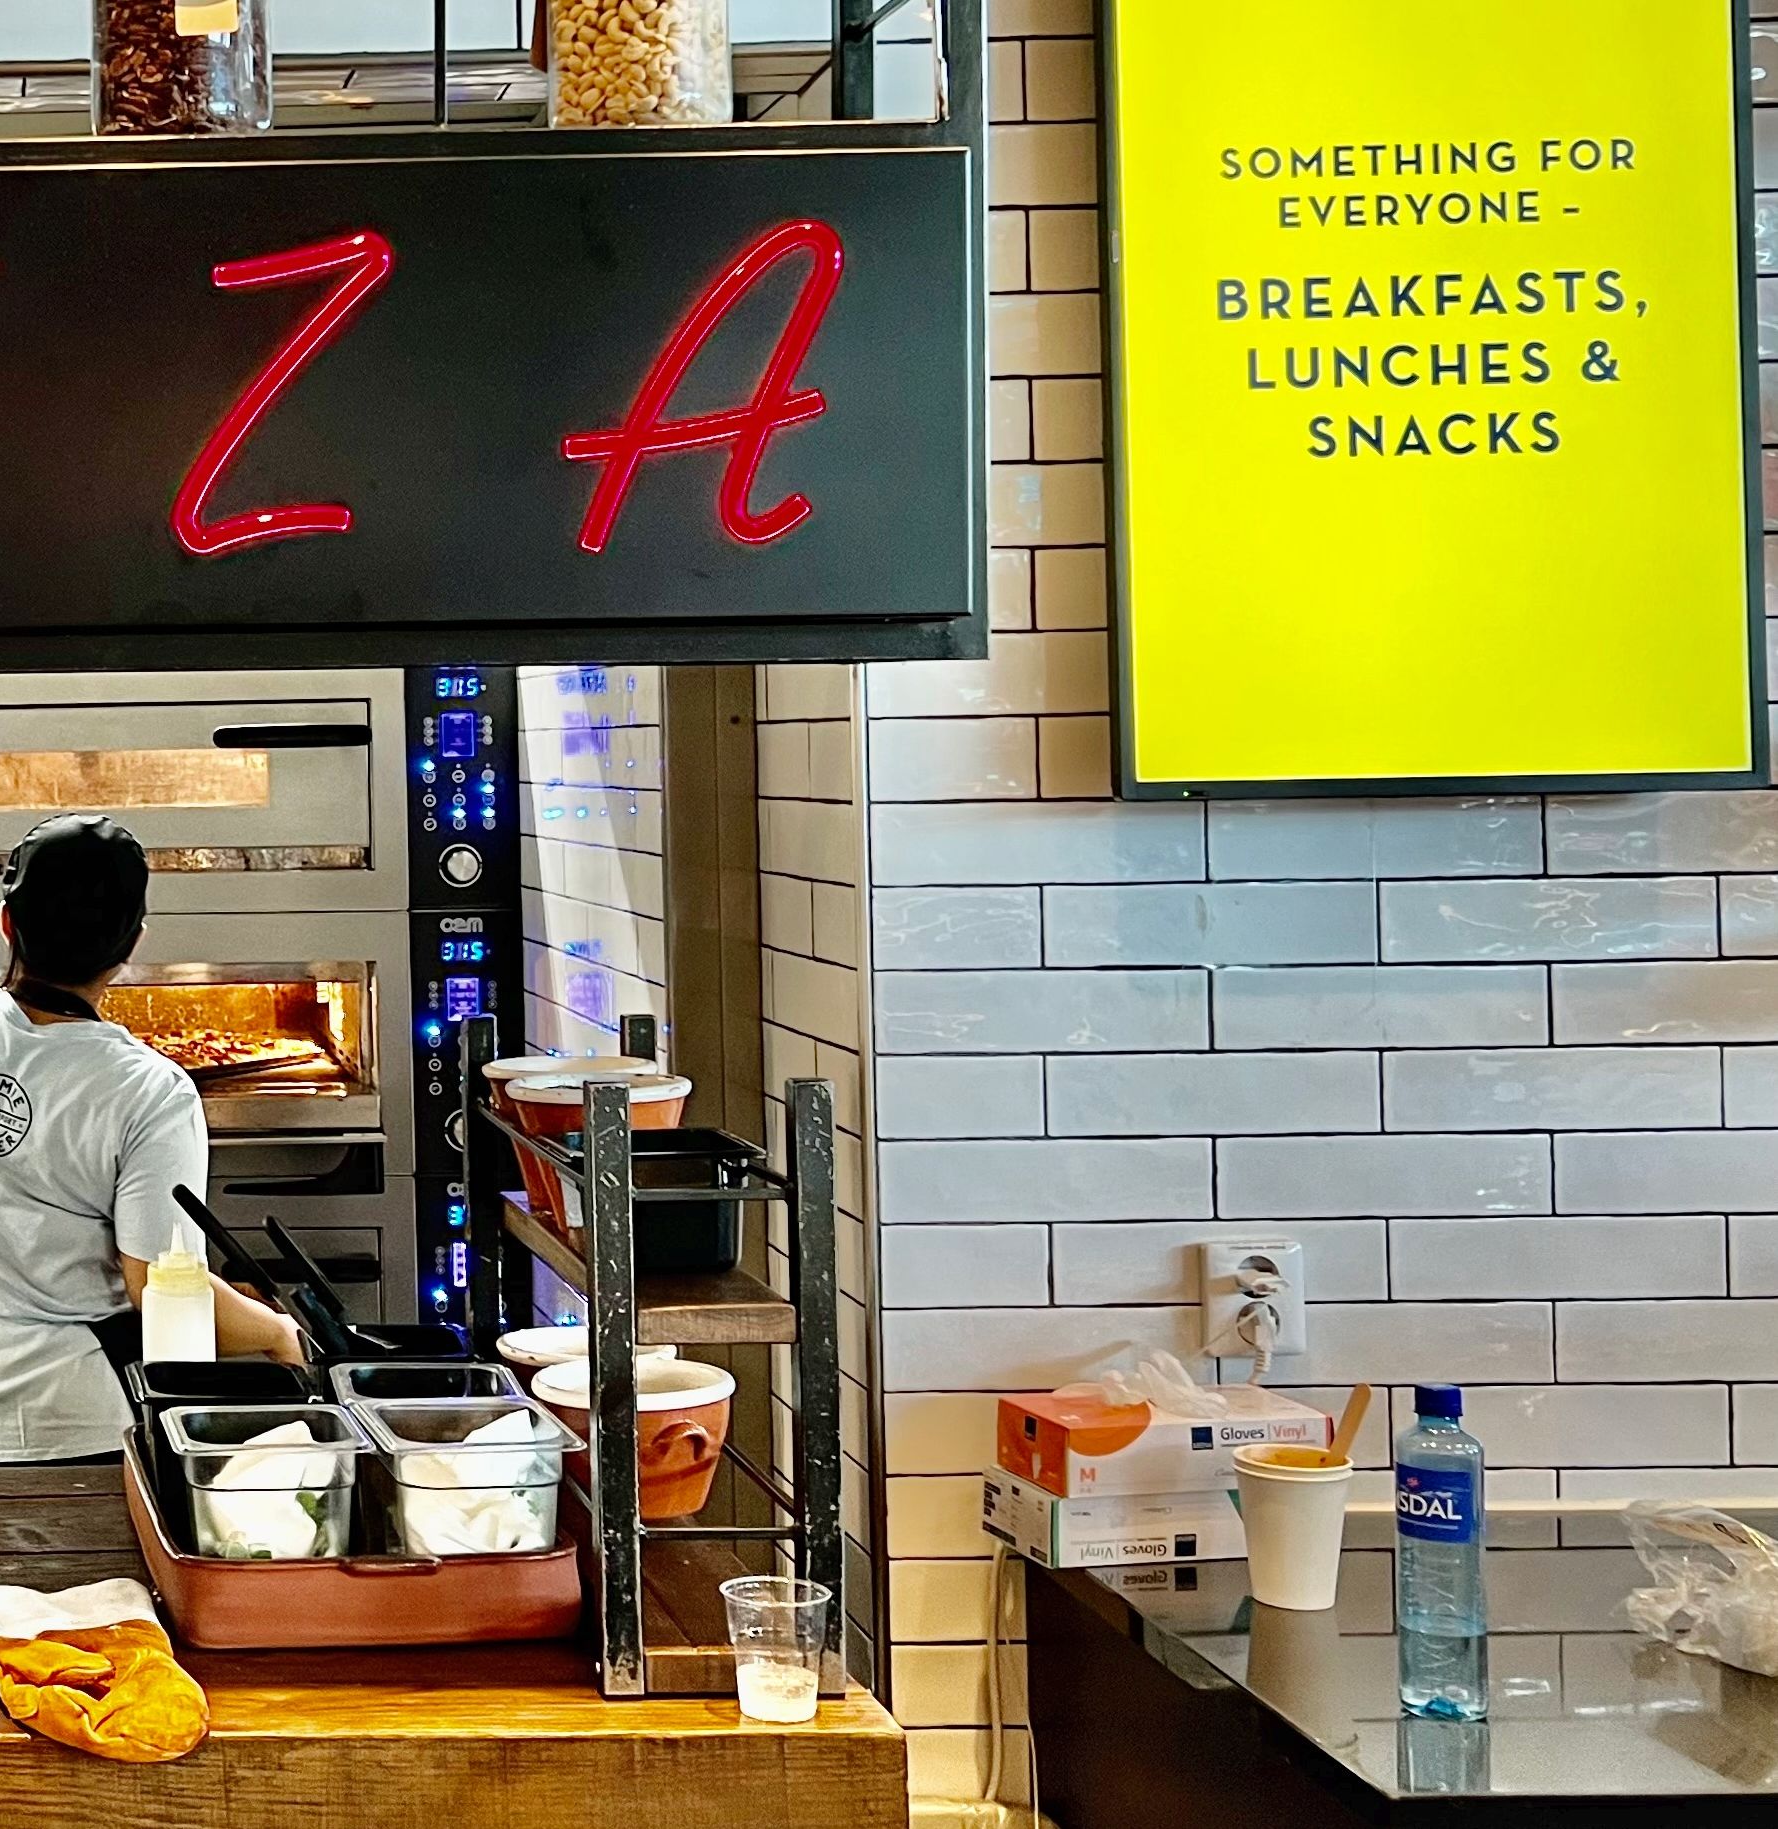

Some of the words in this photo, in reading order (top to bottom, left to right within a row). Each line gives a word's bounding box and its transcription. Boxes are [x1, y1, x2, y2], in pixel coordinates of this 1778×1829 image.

[1220, 140, 1517, 179] SOMETHING
[1540, 138, 1635, 173] FOR
[1279, 190, 1541, 228] EVERYONE
[1217, 269, 1648, 321] BREAKFASTS,
[1248, 340, 1552, 390] LUNCHES
[1581, 339, 1621, 382] &
[1308, 410, 1560, 458] SNACKS
[1220, 1426, 1265, 1441] Gloves
[1273, 1423, 1307, 1440] Vinyl
[1079, 1466, 1097, 1483] M
[1397, 1490, 1463, 1521] SDAL
[1122, 1543, 1168, 1557] Gloves
